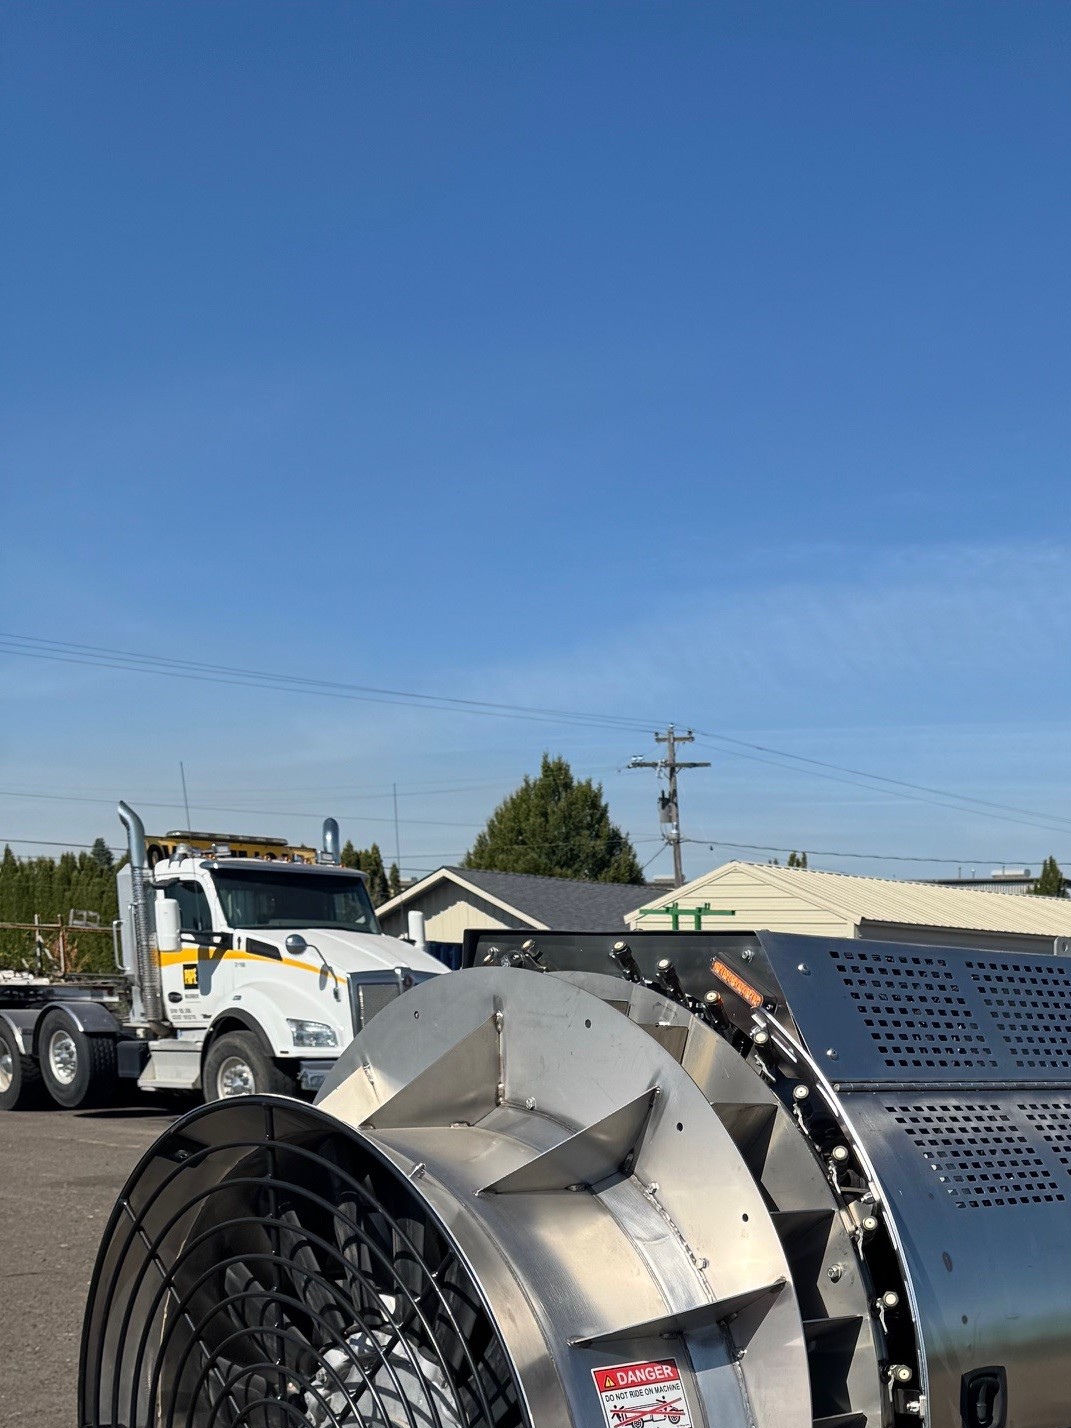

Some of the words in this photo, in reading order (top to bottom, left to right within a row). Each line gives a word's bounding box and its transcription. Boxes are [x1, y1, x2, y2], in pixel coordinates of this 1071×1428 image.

[616, 1365, 674, 1385] DANGER
[604, 1393, 614, 1402] DO
[616, 1392, 628, 1400] NOT
[630, 1389, 644, 1398] RIDE
[645, 1387, 654, 1396] ON
[655, 1383, 681, 1394] MACHINE
